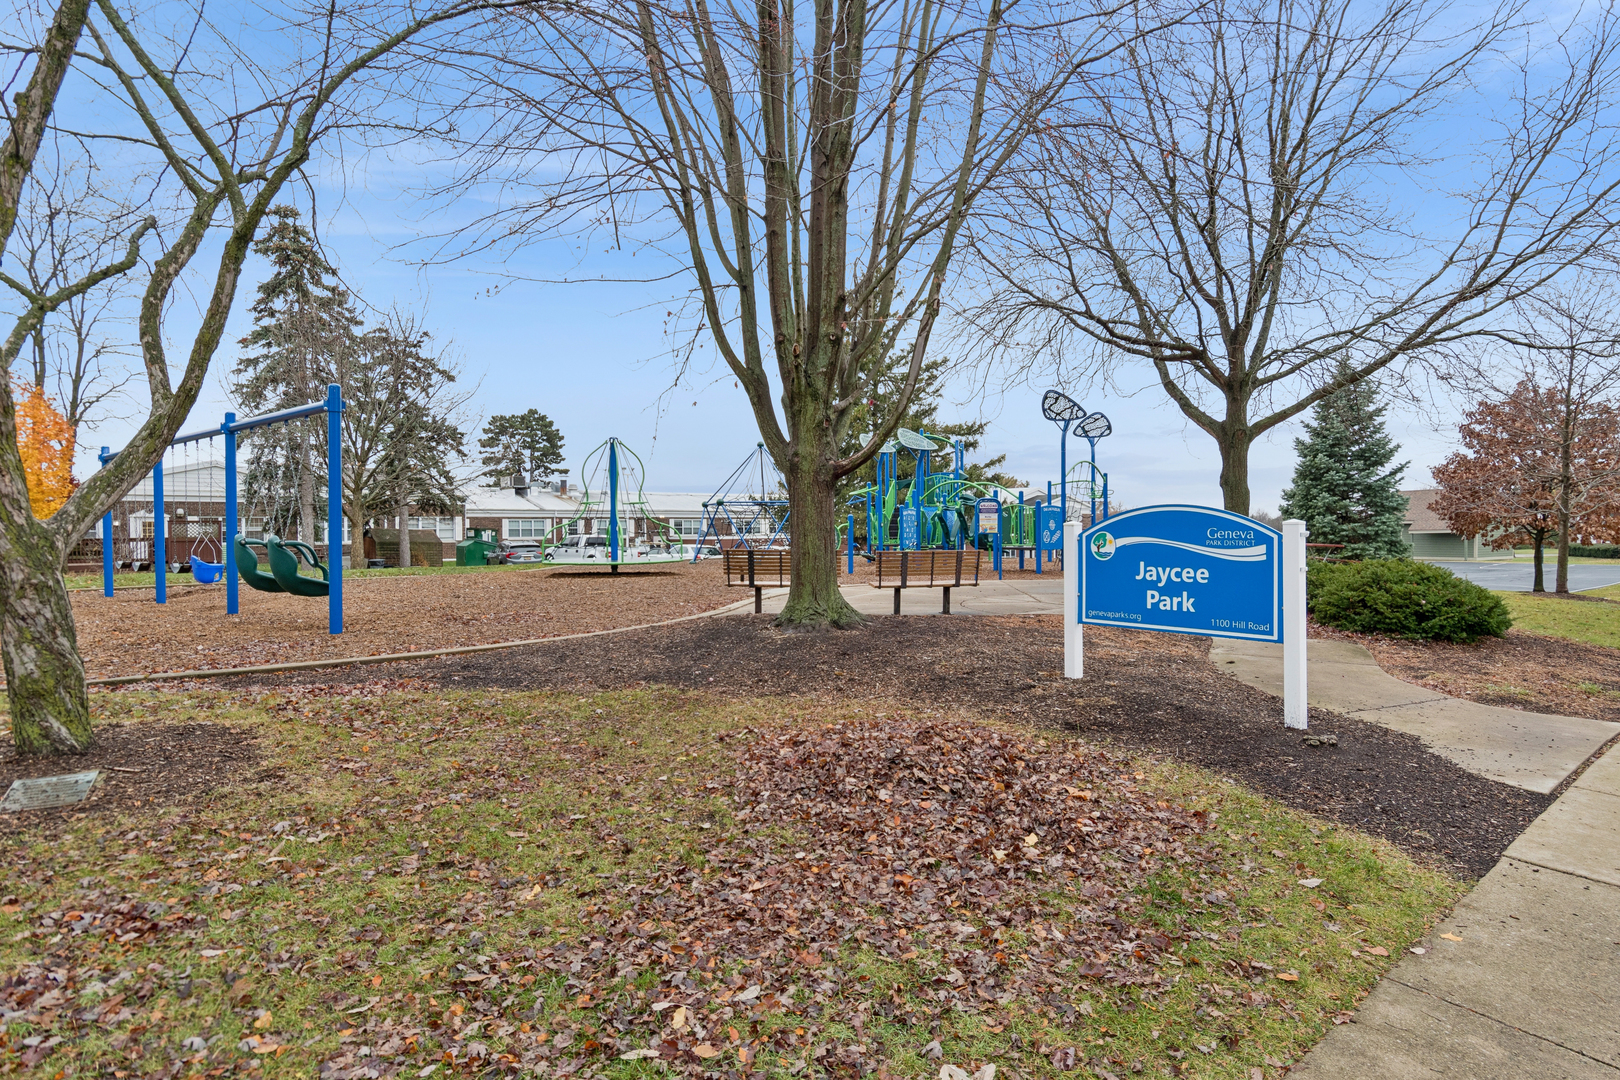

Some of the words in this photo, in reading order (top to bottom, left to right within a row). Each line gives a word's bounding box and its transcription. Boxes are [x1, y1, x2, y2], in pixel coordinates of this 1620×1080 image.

[1207, 527, 1254, 539] Geneva
[1223, 539, 1256, 547] DISTRICT
[1135, 561, 1209, 587] Jaycee
[1146, 590, 1196, 612] Park
[1088, 609, 1142, 622] genevaparks.org
[1211, 618, 1230, 628] 1100
[1232, 620, 1246, 629] Hill
[1248, 621, 1270, 631] Road
